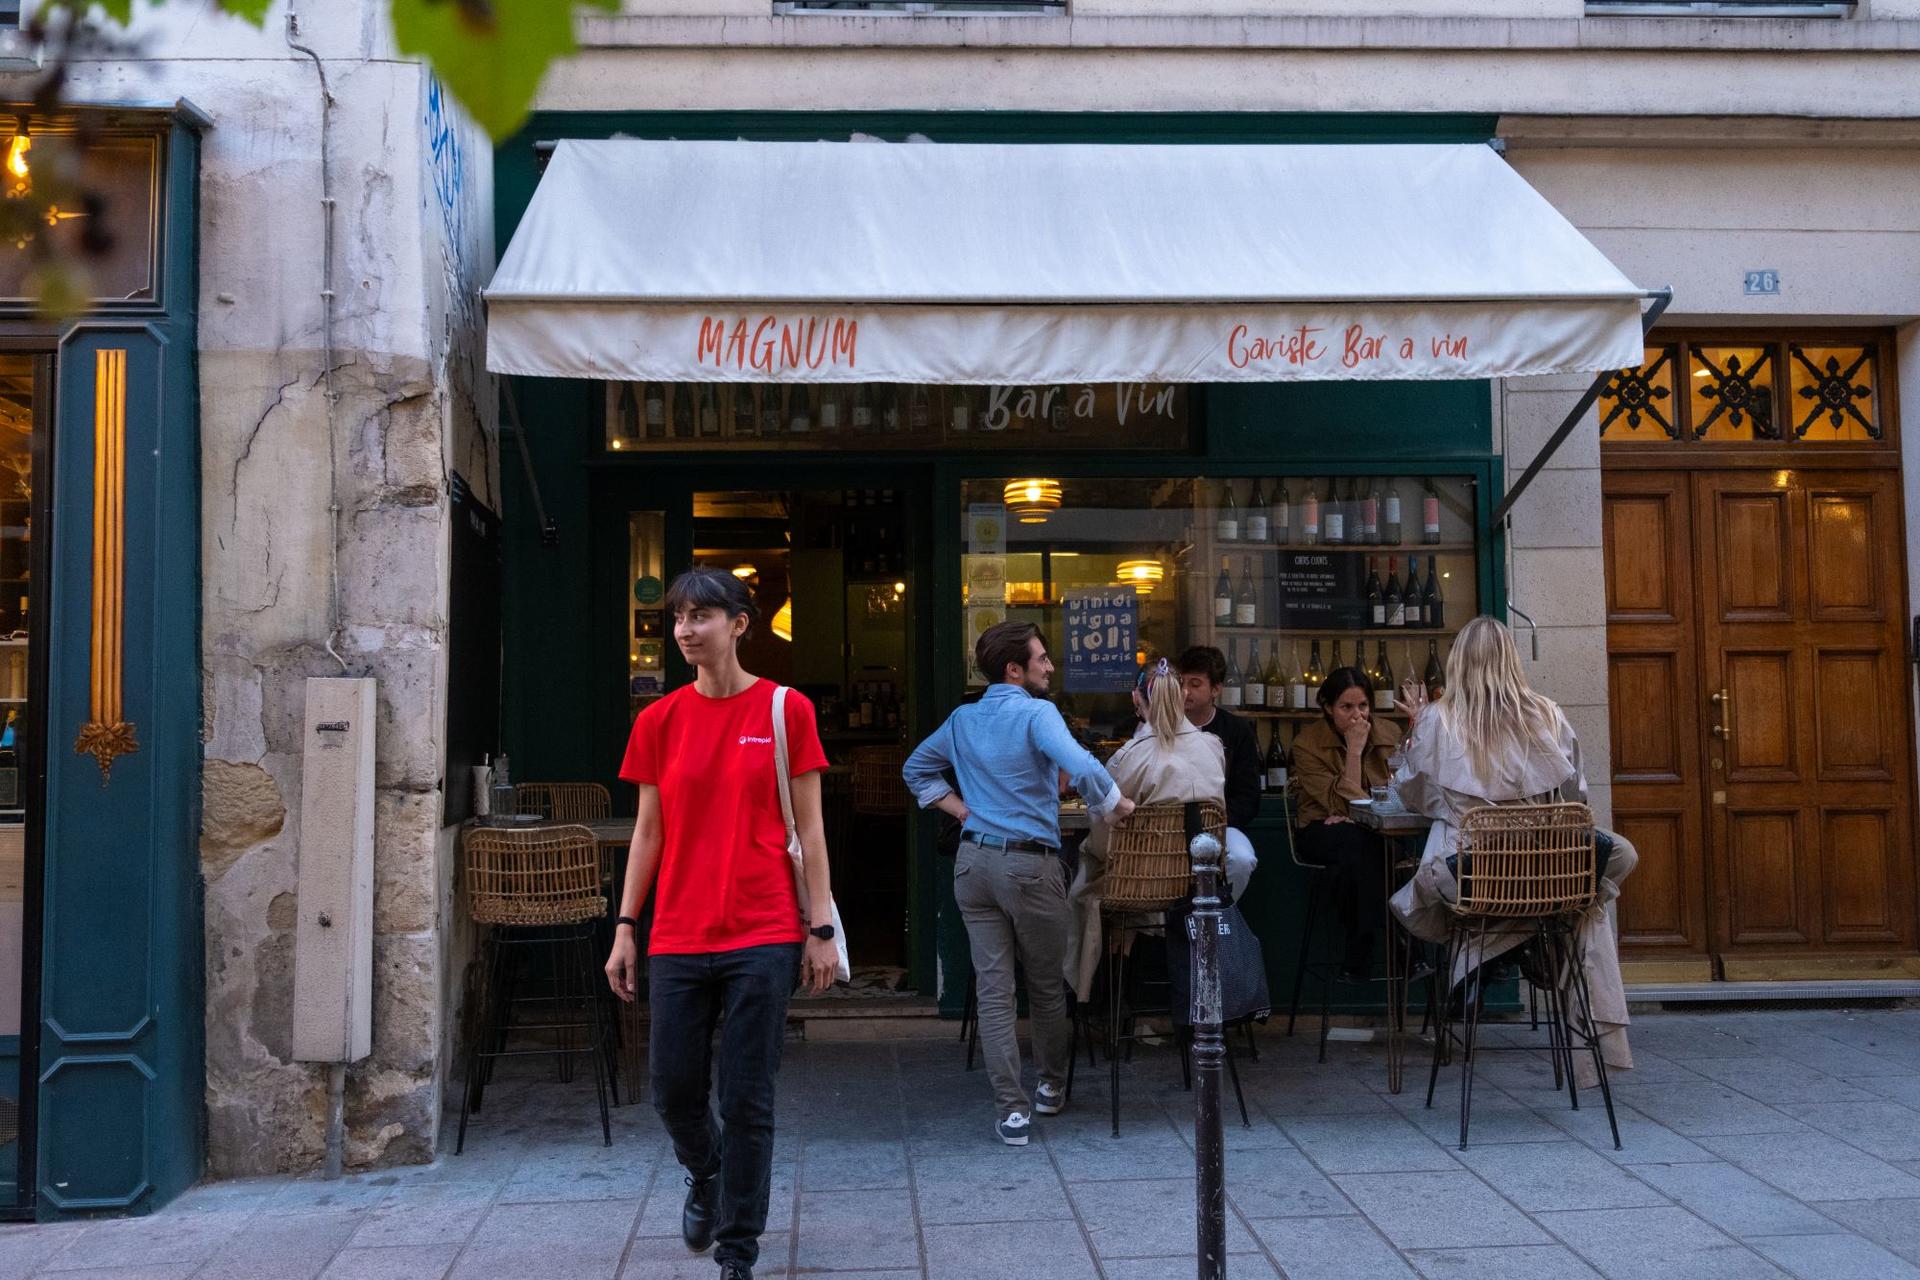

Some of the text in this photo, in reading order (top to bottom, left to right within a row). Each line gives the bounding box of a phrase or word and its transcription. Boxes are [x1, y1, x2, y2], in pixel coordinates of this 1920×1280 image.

[1750, 273, 1774, 291] 26
[698, 315, 857, 373] MAGNUM
[1228, 324, 1467, 368] Caviste Bar a vin
[985, 385, 1060, 430] Bar
[1116, 382, 1175, 426] Vin
